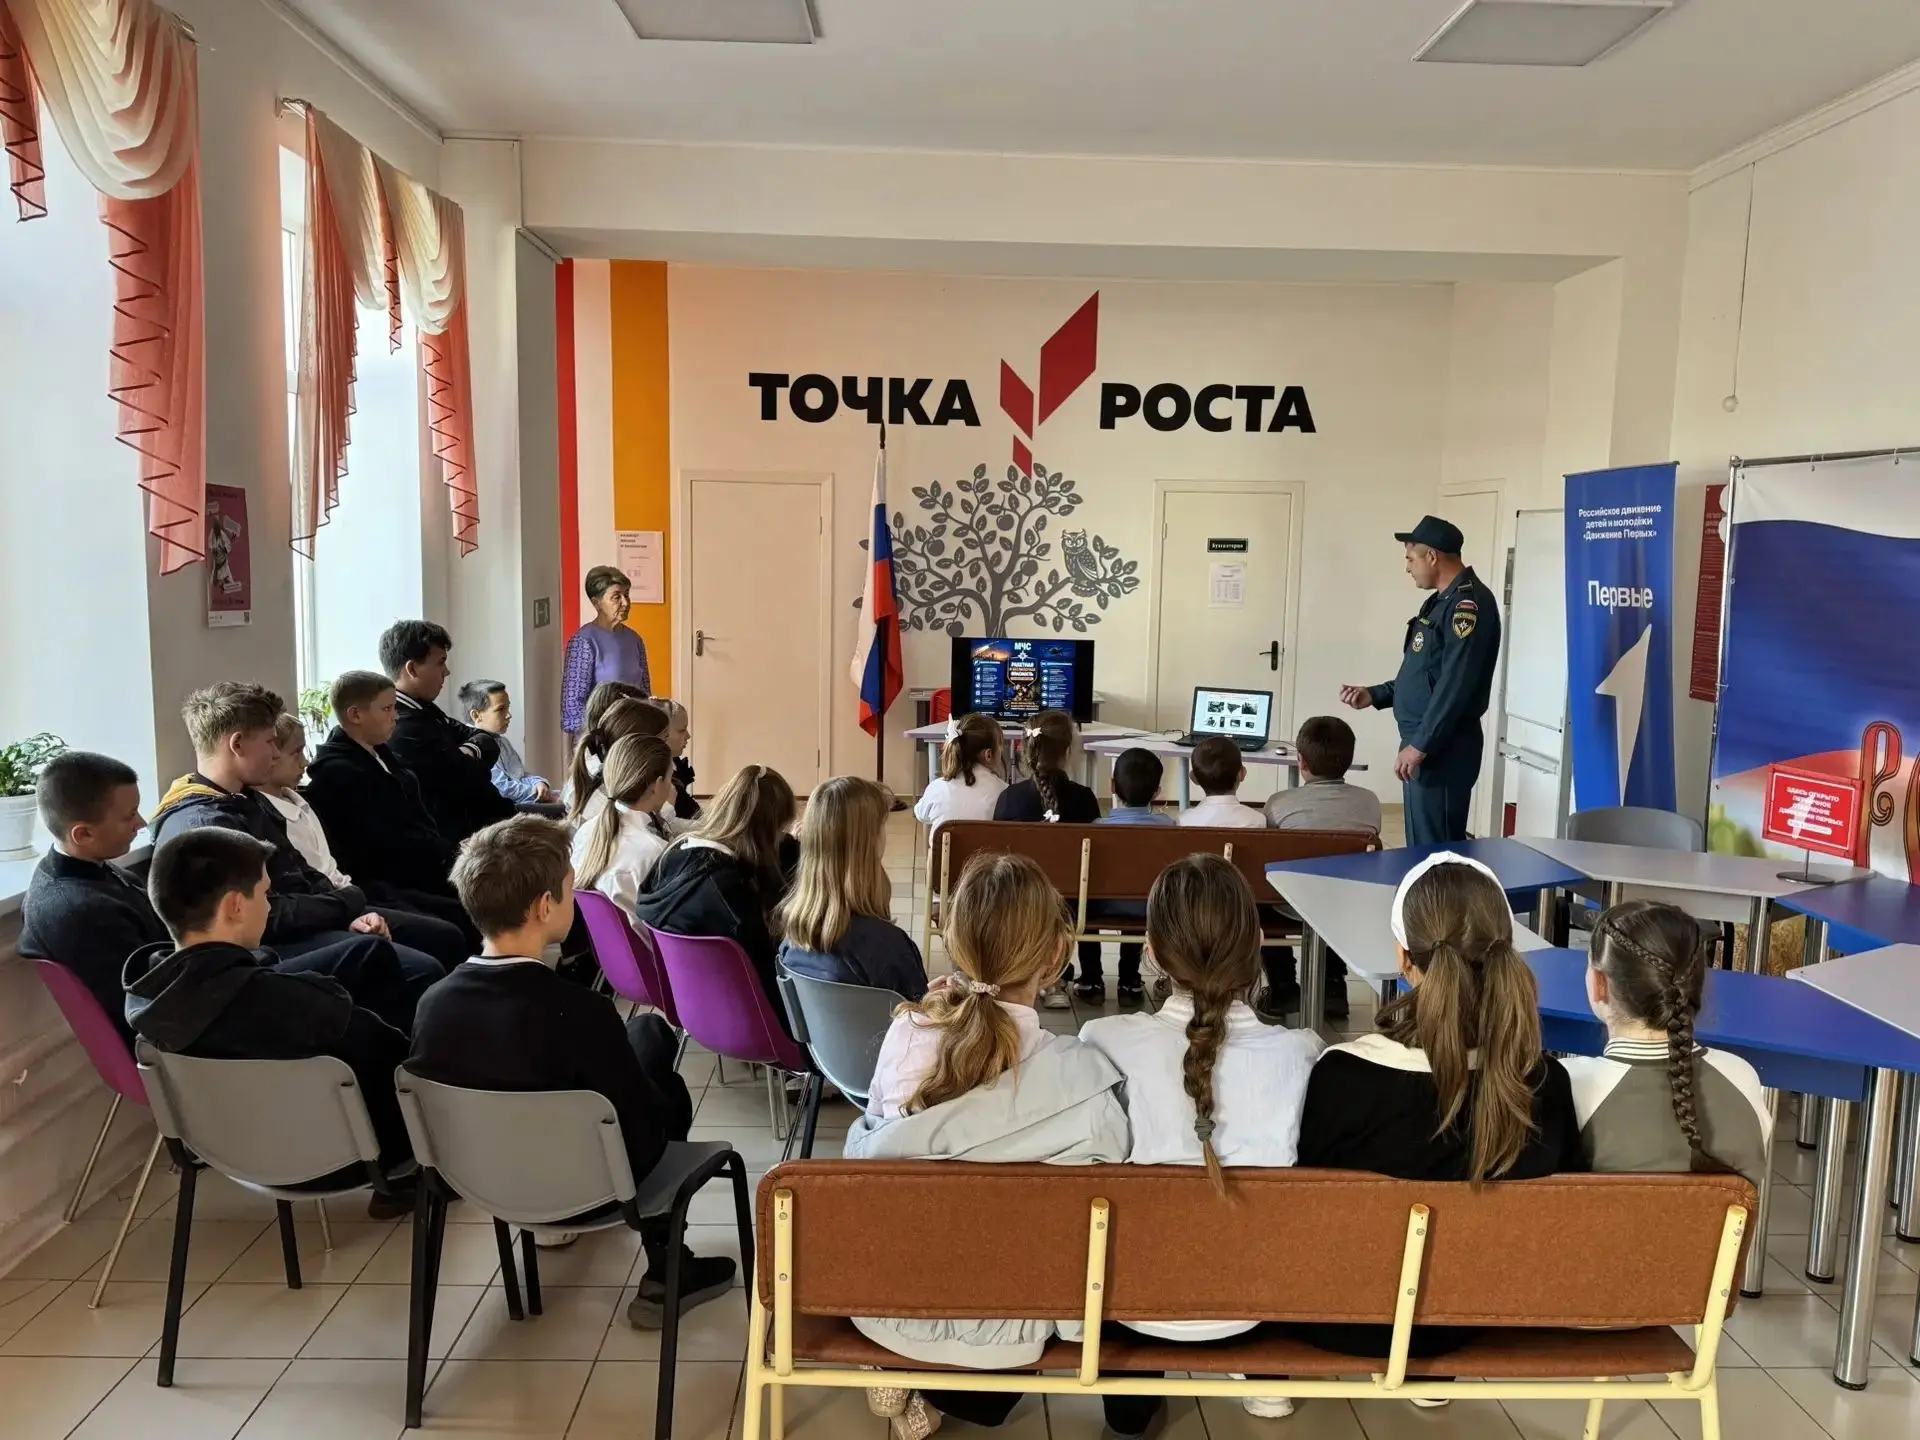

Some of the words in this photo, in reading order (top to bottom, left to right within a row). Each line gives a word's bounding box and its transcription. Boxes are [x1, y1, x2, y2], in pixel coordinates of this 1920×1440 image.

[749, 373, 981, 426] ТОЧКА
[1099, 382, 1317, 433] РОСТА
[1578, 507, 1620, 517] Российское
[1621, 504, 1662, 516] движение
[1585, 518, 1607, 530] детей
[1623, 529, 1657, 540] Первых»
[1588, 580, 1653, 615] Первые
[1014, 642, 1032, 651] МЧС
[1808, 791, 1840, 802] ОТКРЫТО
